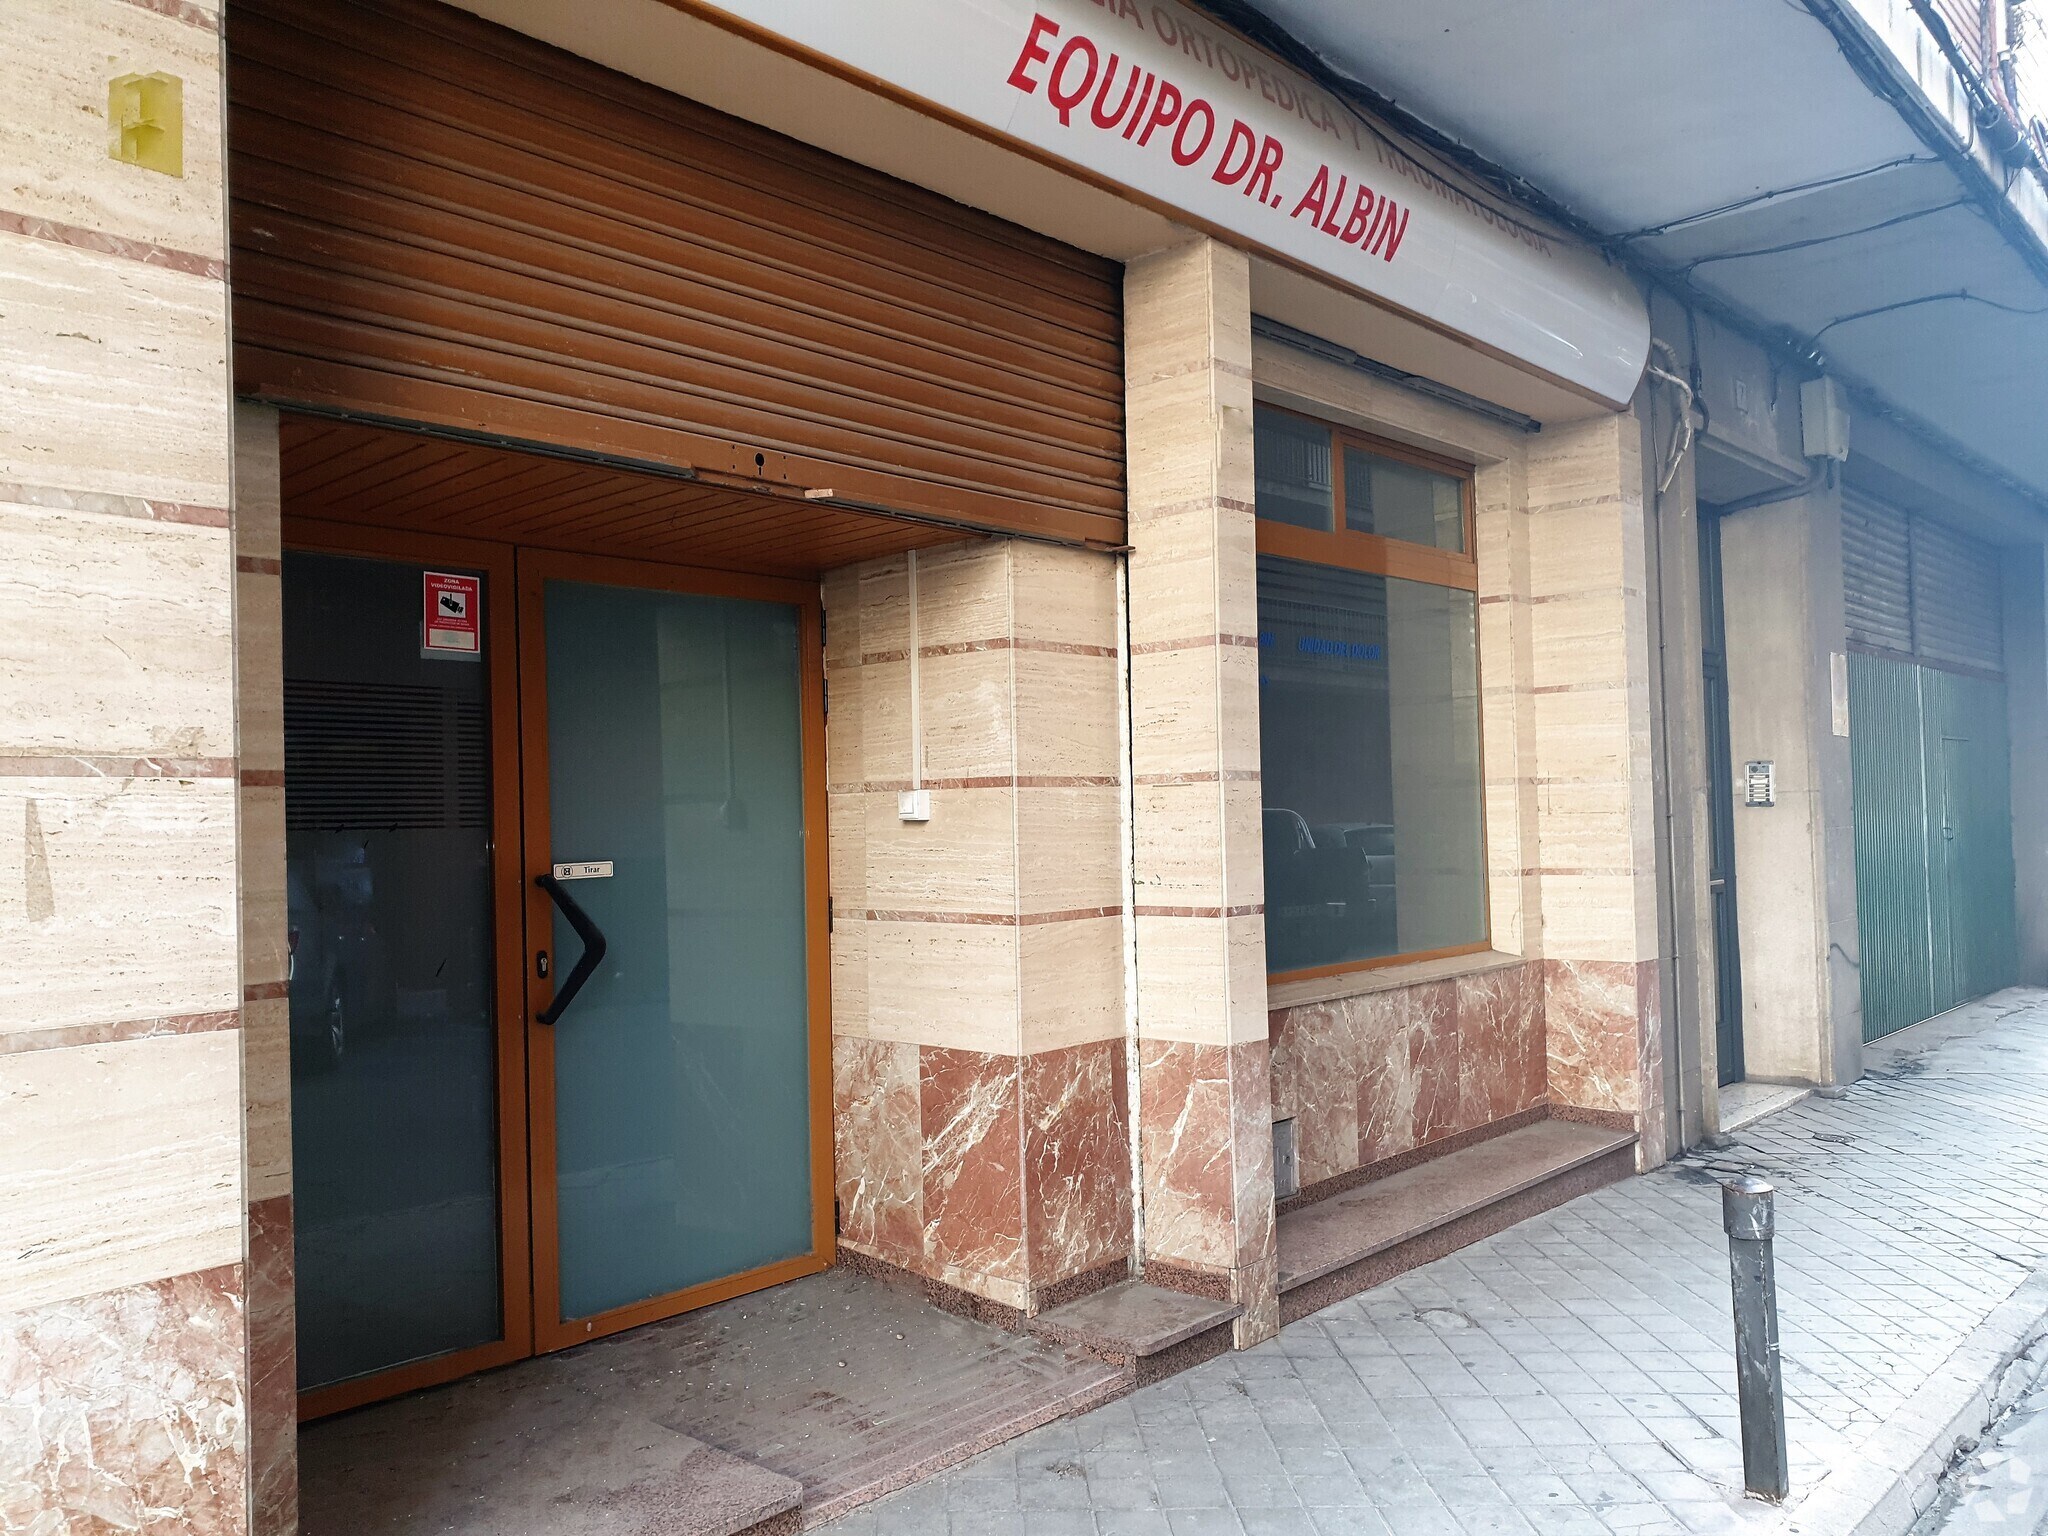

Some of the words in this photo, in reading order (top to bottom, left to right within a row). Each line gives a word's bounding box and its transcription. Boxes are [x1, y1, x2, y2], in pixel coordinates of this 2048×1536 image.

[1006, 12, 1216, 167] EQUIPO
[1211, 118, 1283, 210] DR.
[1291, 163, 1410, 263] ALBIN
[1151, 5, 1341, 140] ORTOPEDICA
[1342, 111, 1360, 151] Y
[583, 866, 600, 874] Tirar
